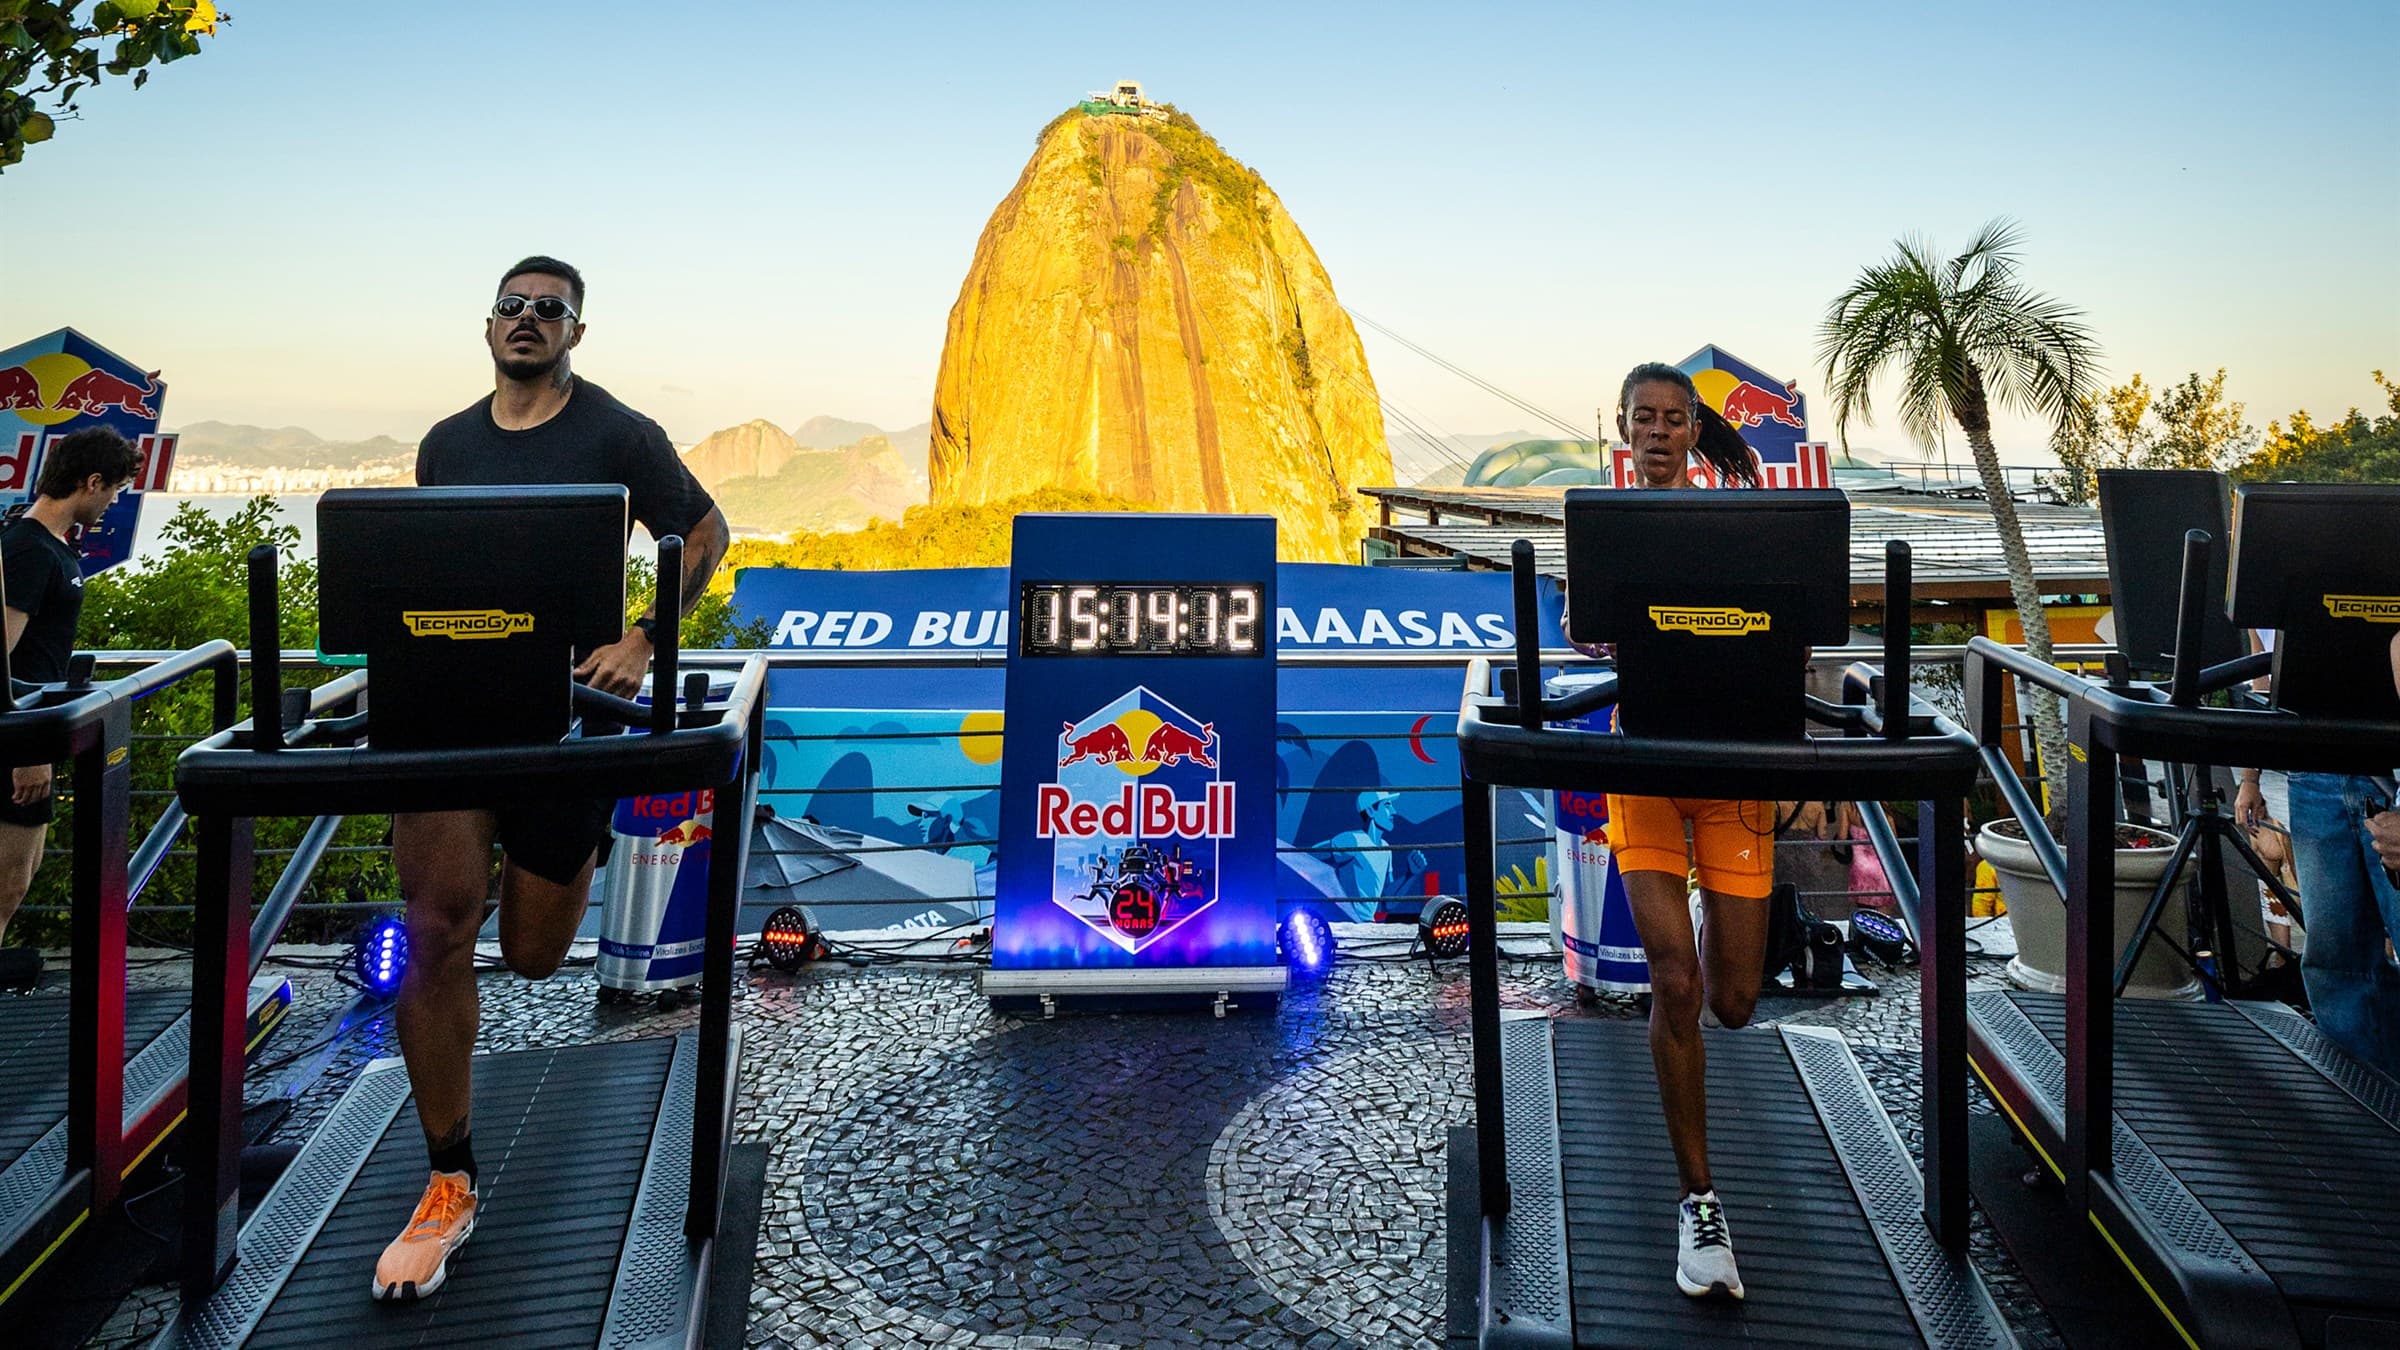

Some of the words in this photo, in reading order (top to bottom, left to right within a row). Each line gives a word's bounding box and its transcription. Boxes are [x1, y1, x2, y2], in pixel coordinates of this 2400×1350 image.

[406, 613, 530, 634] TECHNOGYM
[769, 610, 893, 646] RED
[1051, 590, 1255, 649] 15:14:12
[1651, 610, 1767, 630] TECHNOGYM
[1040, 786, 1133, 836] Red
[1143, 786, 1232, 836] Bull
[632, 852, 681, 866] ENERG
[1566, 848, 1608, 866] ENERG
[1117, 889, 1153, 918] 24
